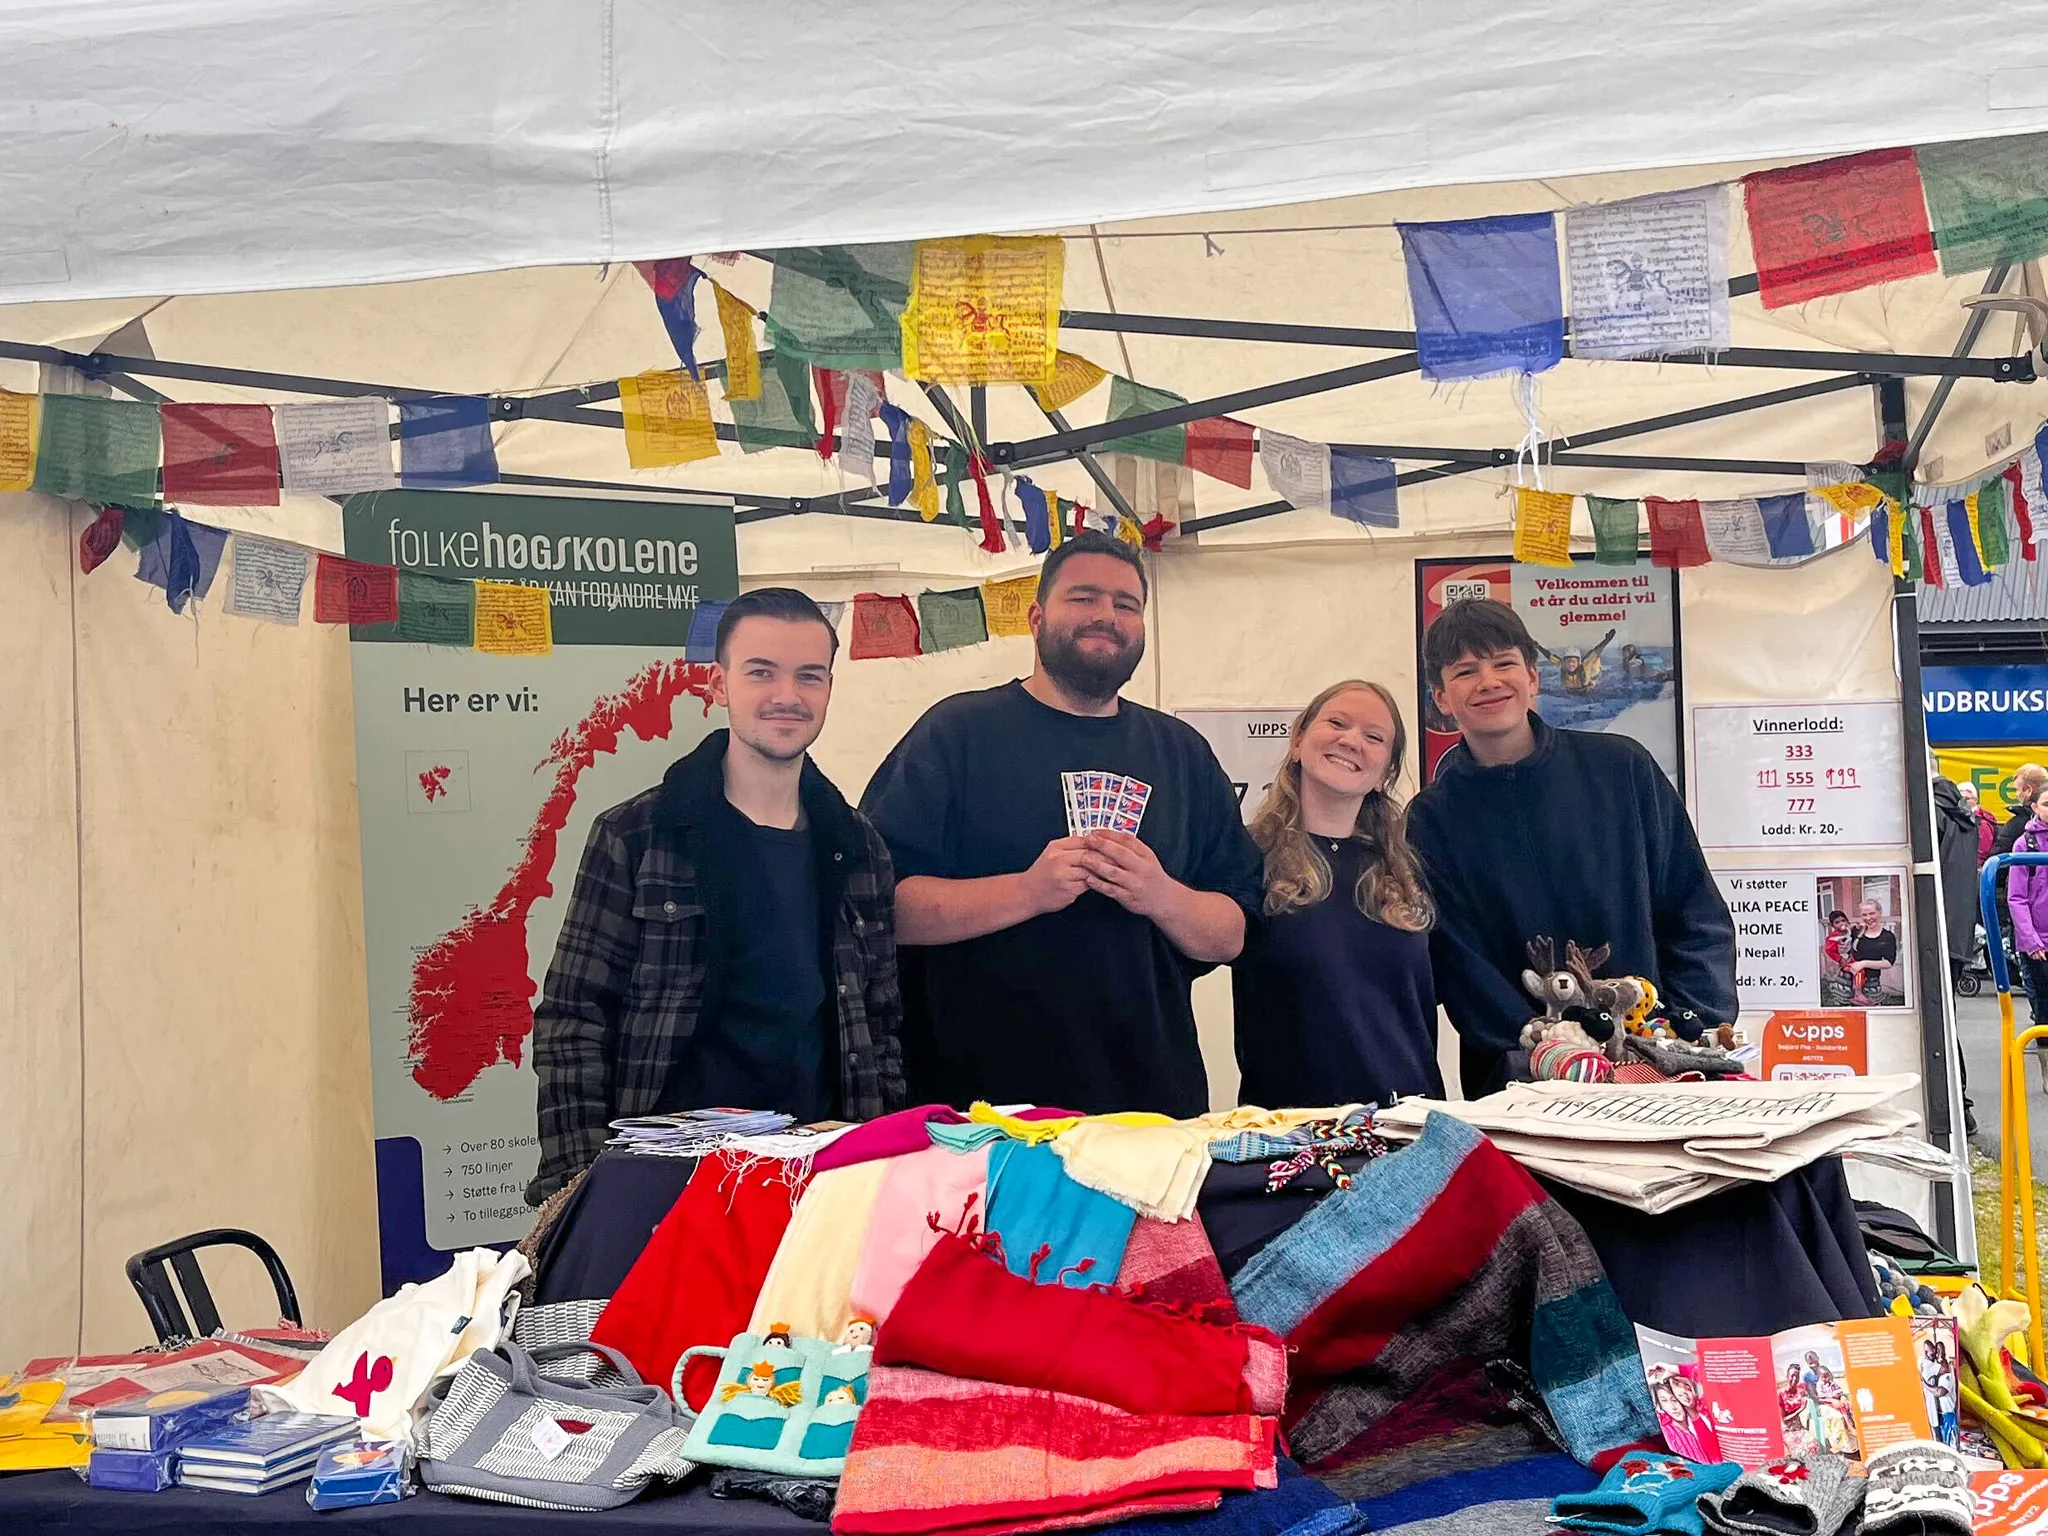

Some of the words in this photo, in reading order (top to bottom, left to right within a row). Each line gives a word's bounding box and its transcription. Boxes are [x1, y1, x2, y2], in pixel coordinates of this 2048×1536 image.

[1536, 577, 1630, 591] Velkommen
[1632, 575, 1649, 588] til
[547, 581, 576, 606] KAN
[581, 581, 664, 609] FORANDRE
[1530, 596, 1544, 607] et
[1548, 594, 1566, 607] år
[1569, 593, 1589, 606] du
[1592, 593, 1631, 605] aldri
[1634, 592, 1656, 604] vil
[1559, 610, 1626, 627] glemme!
[404, 687, 460, 713] Her
[468, 690, 499, 713] er
[506, 685, 539, 712] vi:
[1922, 690, 2048, 713] NDBRUKS
[1247, 723, 1291, 736] VIPPS:
[1753, 717, 1844, 733] Vinnerlodd:
[1785, 745, 1814, 758] 333
[1756, 768, 1779, 786] 111
[1786, 771, 1814, 784] 555
[1971, 767, 2022, 805] Fe
[1787, 798, 1815, 812] 777
[1761, 823, 1796, 836] Lodd:
[1799, 824, 1816, 835] Kr.
[1819, 823, 1843, 836] 20,-
[1730, 879, 1742, 889] Vi
[1746, 879, 1788, 890] støtter
[1730, 901, 1761, 913] LIKA
[1765, 900, 1809, 912] PEACE
[1739, 923, 1783, 935] HOME
[1744, 946, 1785, 960] Nepal!
[1736, 975, 1756, 986] dd:
[1759, 975, 1776, 986] Kr.
[1779, 975, 1804, 988] 20,-
[460, 1141, 488, 1153] Over
[490, 1138, 505, 1150] 80
[461, 1163, 483, 1176] 750
[485, 1161, 514, 1174] linjer
[463, 1185, 497, 1199] Støtte
[500, 1183, 516, 1194] fra
[463, 1210, 477, 1222] To
[479, 1204, 539, 1220] tilleggspoe
